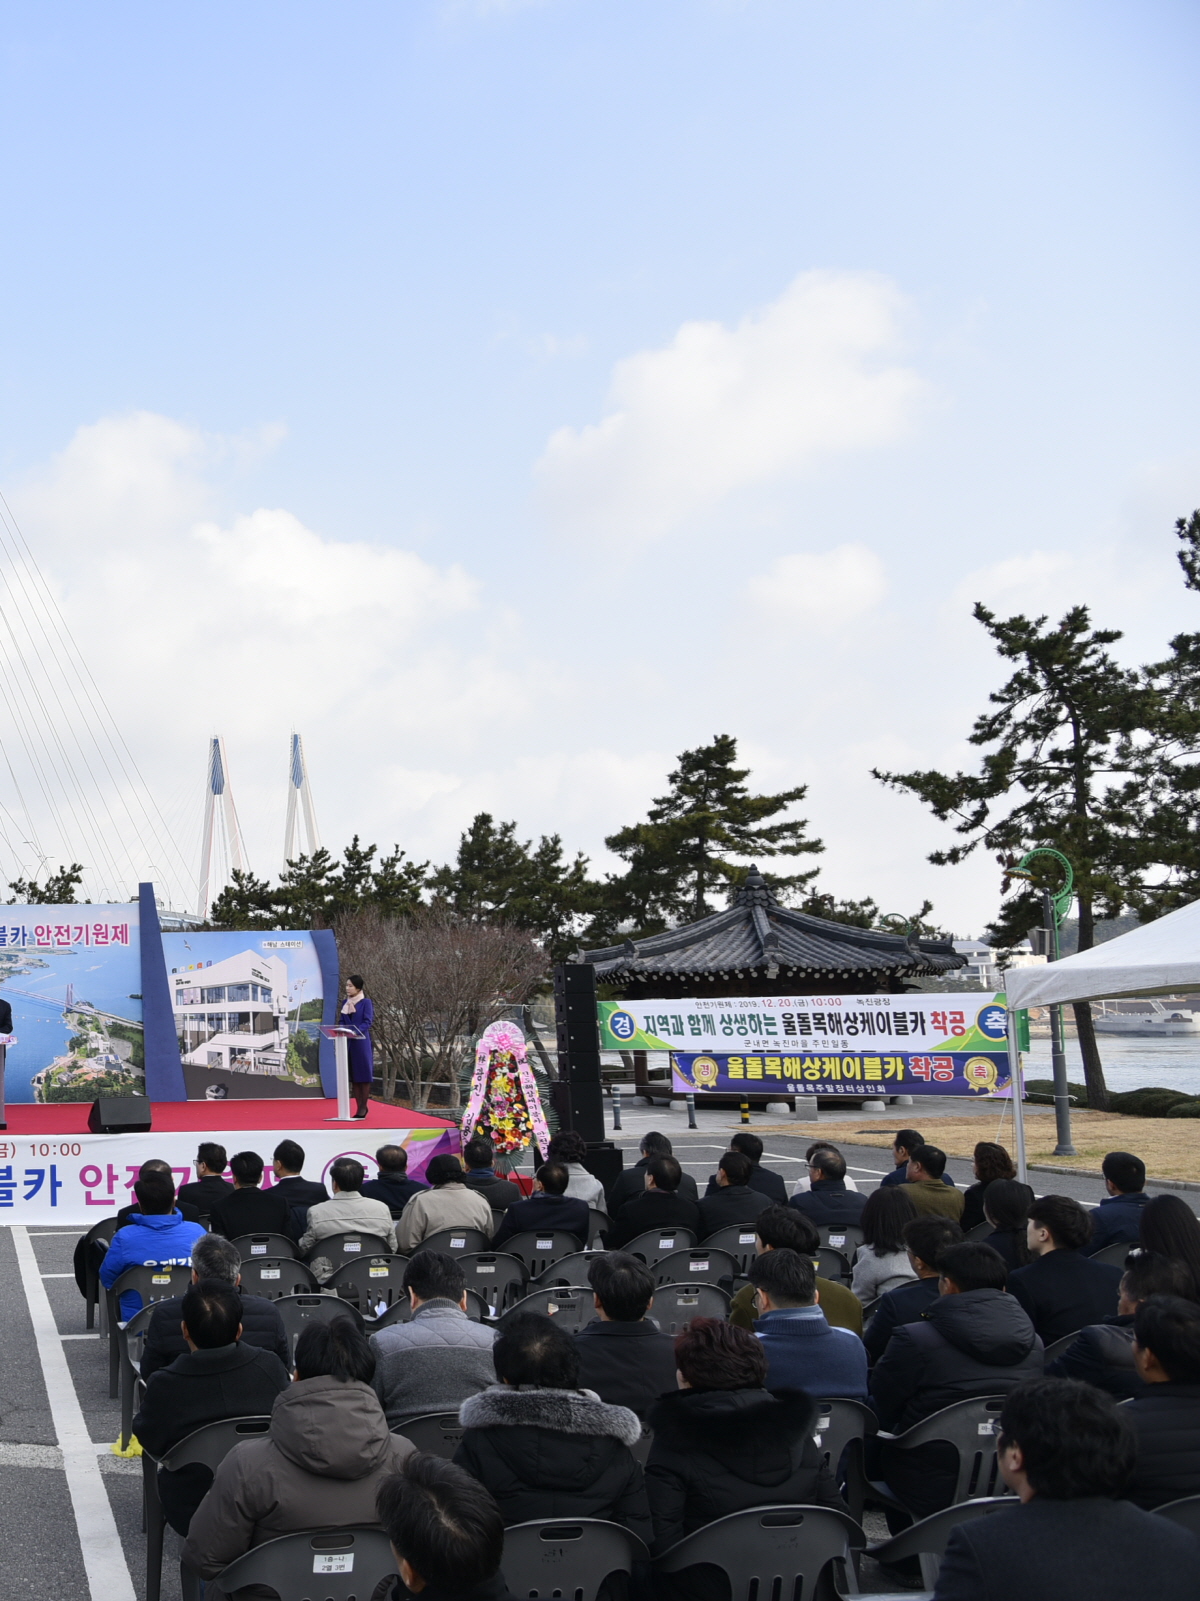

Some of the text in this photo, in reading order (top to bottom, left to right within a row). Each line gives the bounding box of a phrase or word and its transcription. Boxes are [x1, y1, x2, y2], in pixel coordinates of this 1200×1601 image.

[34, 923, 130, 946] 안전기원제
[810, 997, 842, 1007] 10:00
[614, 1015, 631, 1035] 경
[643, 1010, 966, 1037] 지역과 함께 상생하는 울돌목해상케이블카 착공
[699, 1064, 711, 1076] 경
[727, 1055, 955, 1082] 울돌목해상케이블카 착공
[974, 1065, 987, 1079] 축
[29, 1142, 82, 1157] 10:00
